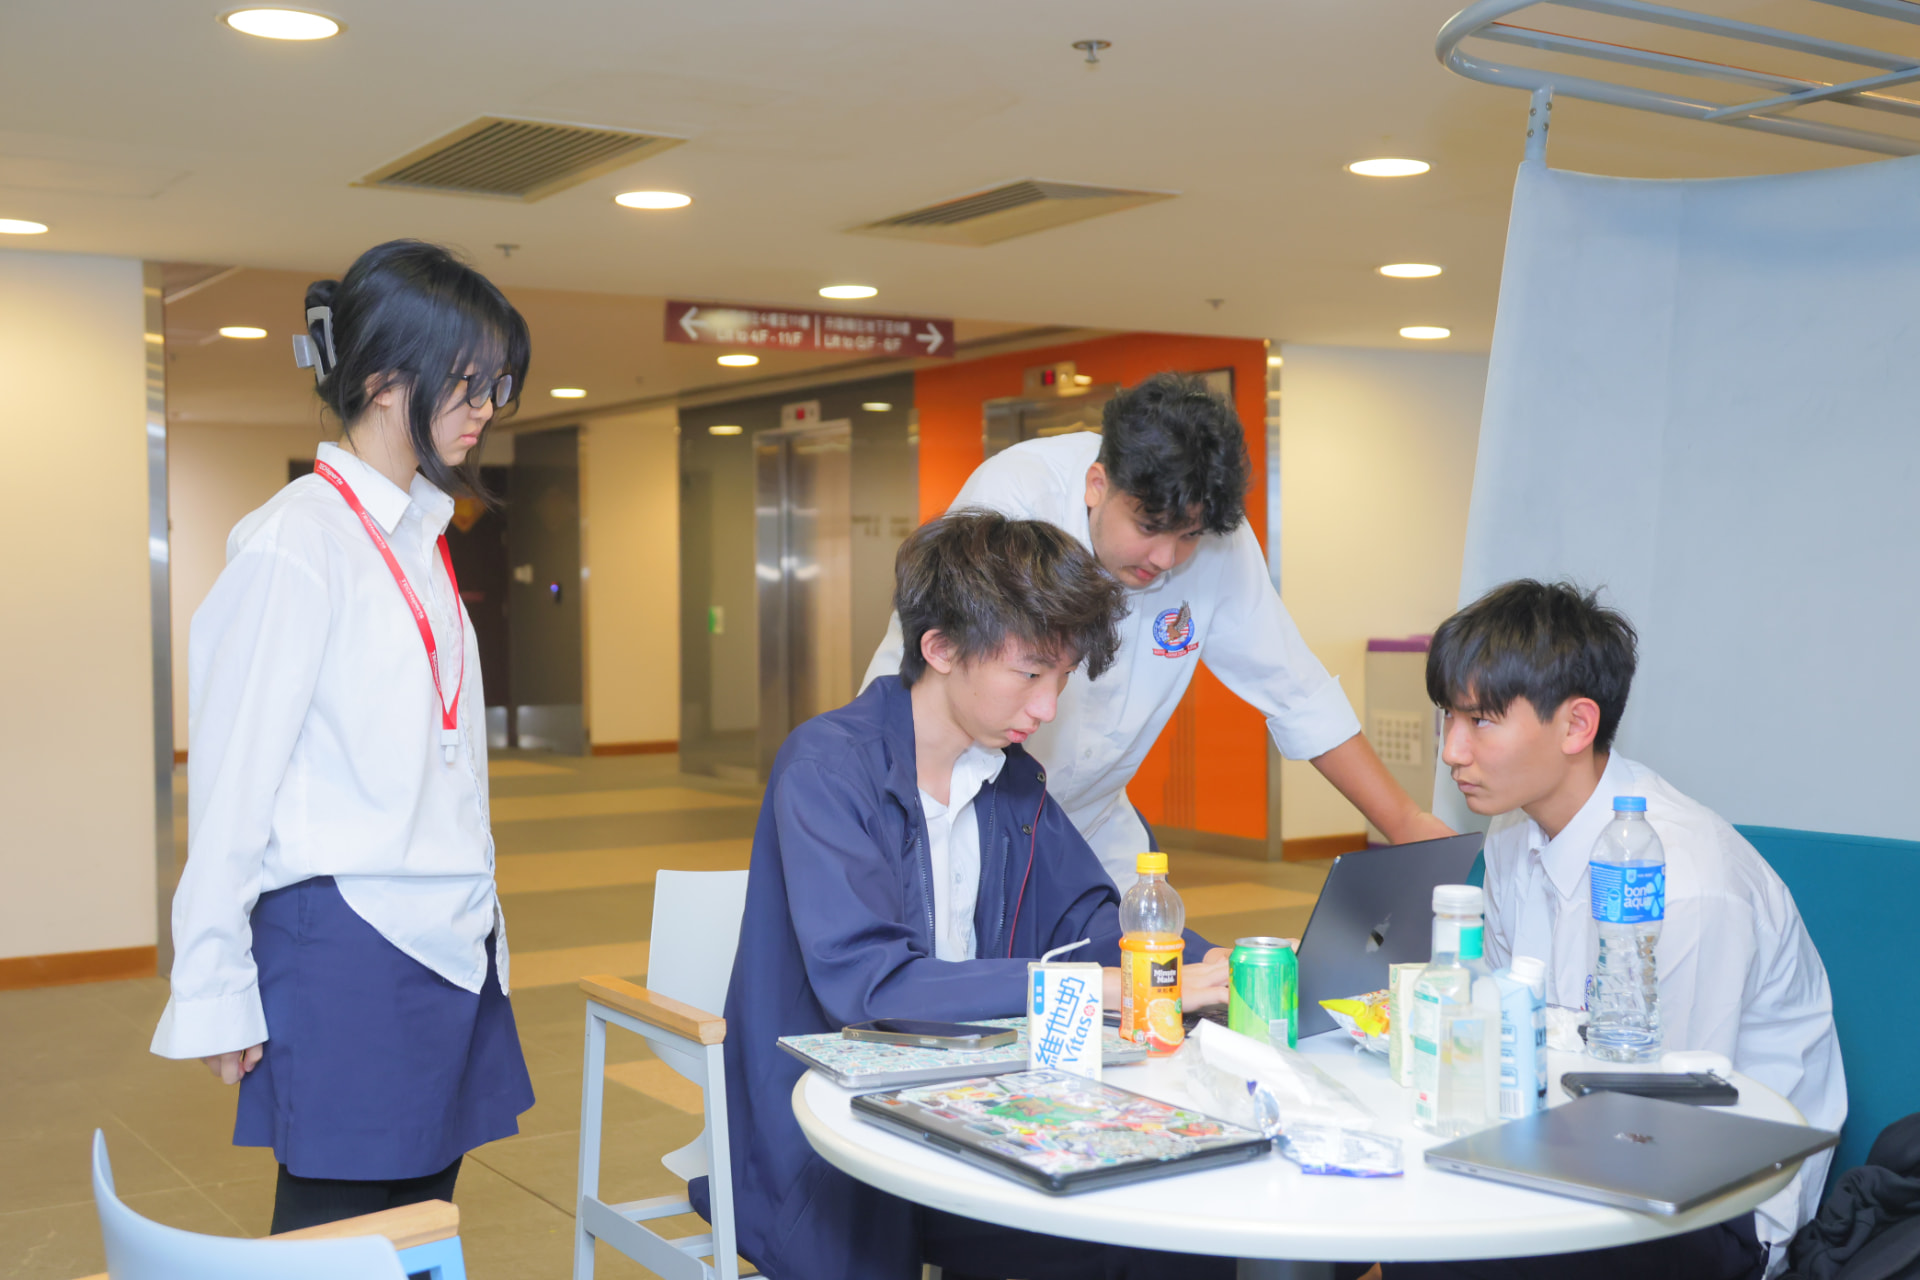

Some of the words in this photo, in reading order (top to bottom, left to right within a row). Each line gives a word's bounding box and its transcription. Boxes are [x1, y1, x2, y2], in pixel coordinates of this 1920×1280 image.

[1623, 883, 1648, 897] bon
[1035, 976, 1085, 1069] 維他奶
